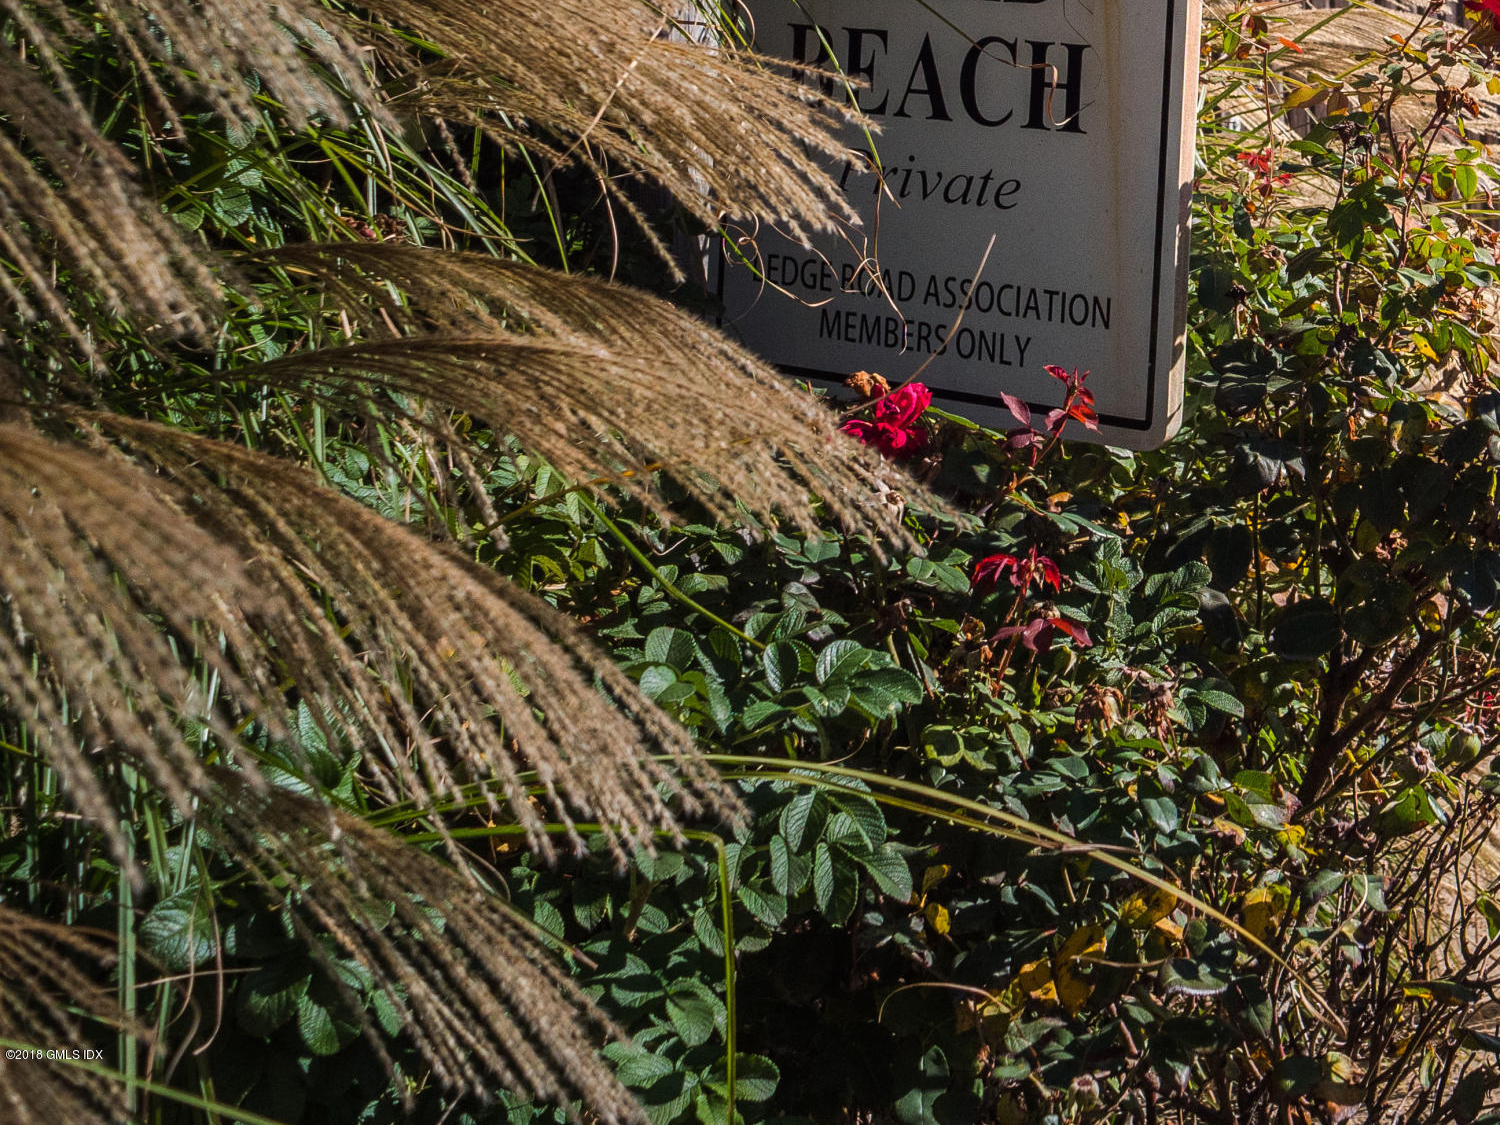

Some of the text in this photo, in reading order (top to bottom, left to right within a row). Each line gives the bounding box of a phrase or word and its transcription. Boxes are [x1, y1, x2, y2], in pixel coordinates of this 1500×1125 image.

[787, 23, 1091, 134] BEACH
[752, 253, 1112, 329] LEDGE ROAD ASSOCIATION
[818, 309, 1032, 367] MEMBERS ONLY
